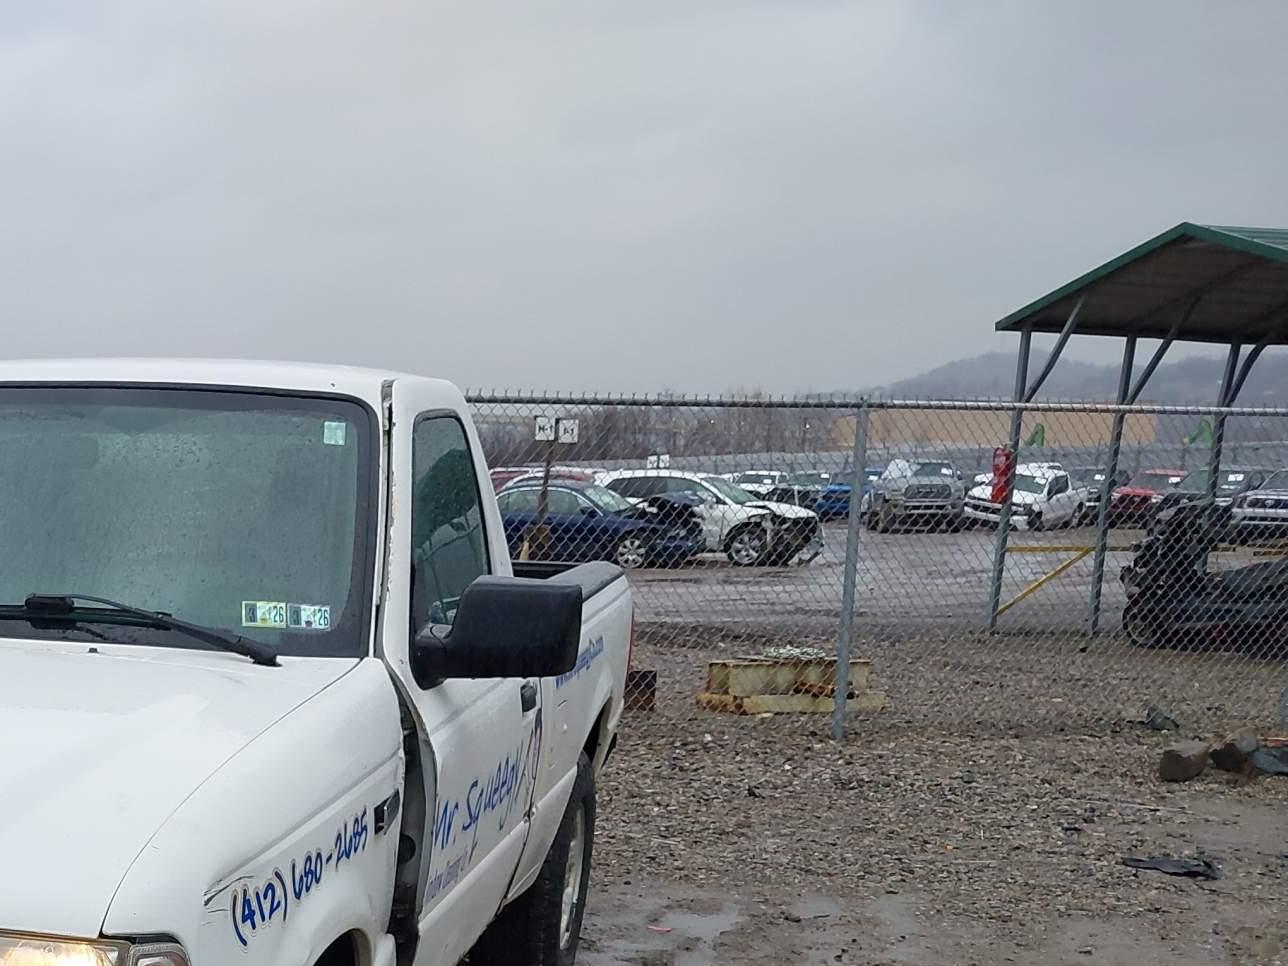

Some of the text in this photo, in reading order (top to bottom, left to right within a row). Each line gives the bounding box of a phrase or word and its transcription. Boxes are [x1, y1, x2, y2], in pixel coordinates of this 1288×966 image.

[273, 606, 285, 623] 26
[318, 608, 330, 626] 26
[232, 869, 288, 947] (412)
[291, 808, 369, 900] 680-2685
